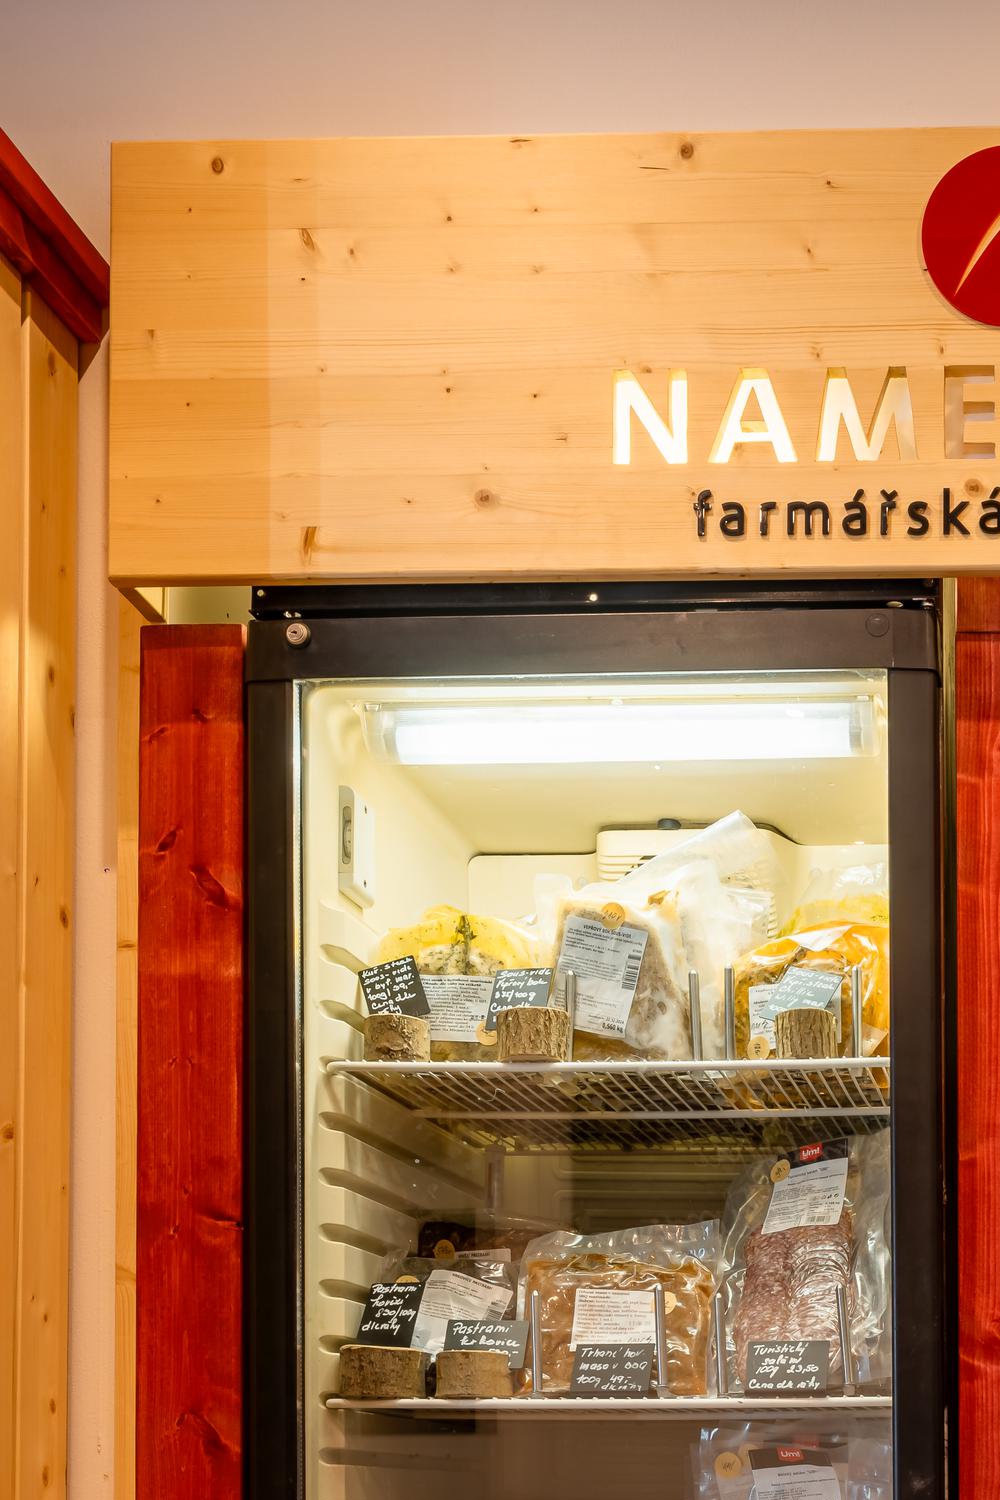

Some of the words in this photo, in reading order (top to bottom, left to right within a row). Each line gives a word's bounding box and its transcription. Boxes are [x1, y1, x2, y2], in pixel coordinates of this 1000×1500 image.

[452, 1321, 513, 1336] Pastrami
[579, 1362, 609, 1371] maso
[755, 1365, 780, 1379] 100g
[786, 1363, 819, 1374] 23,50
[748, 1378, 774, 1389] Cena
